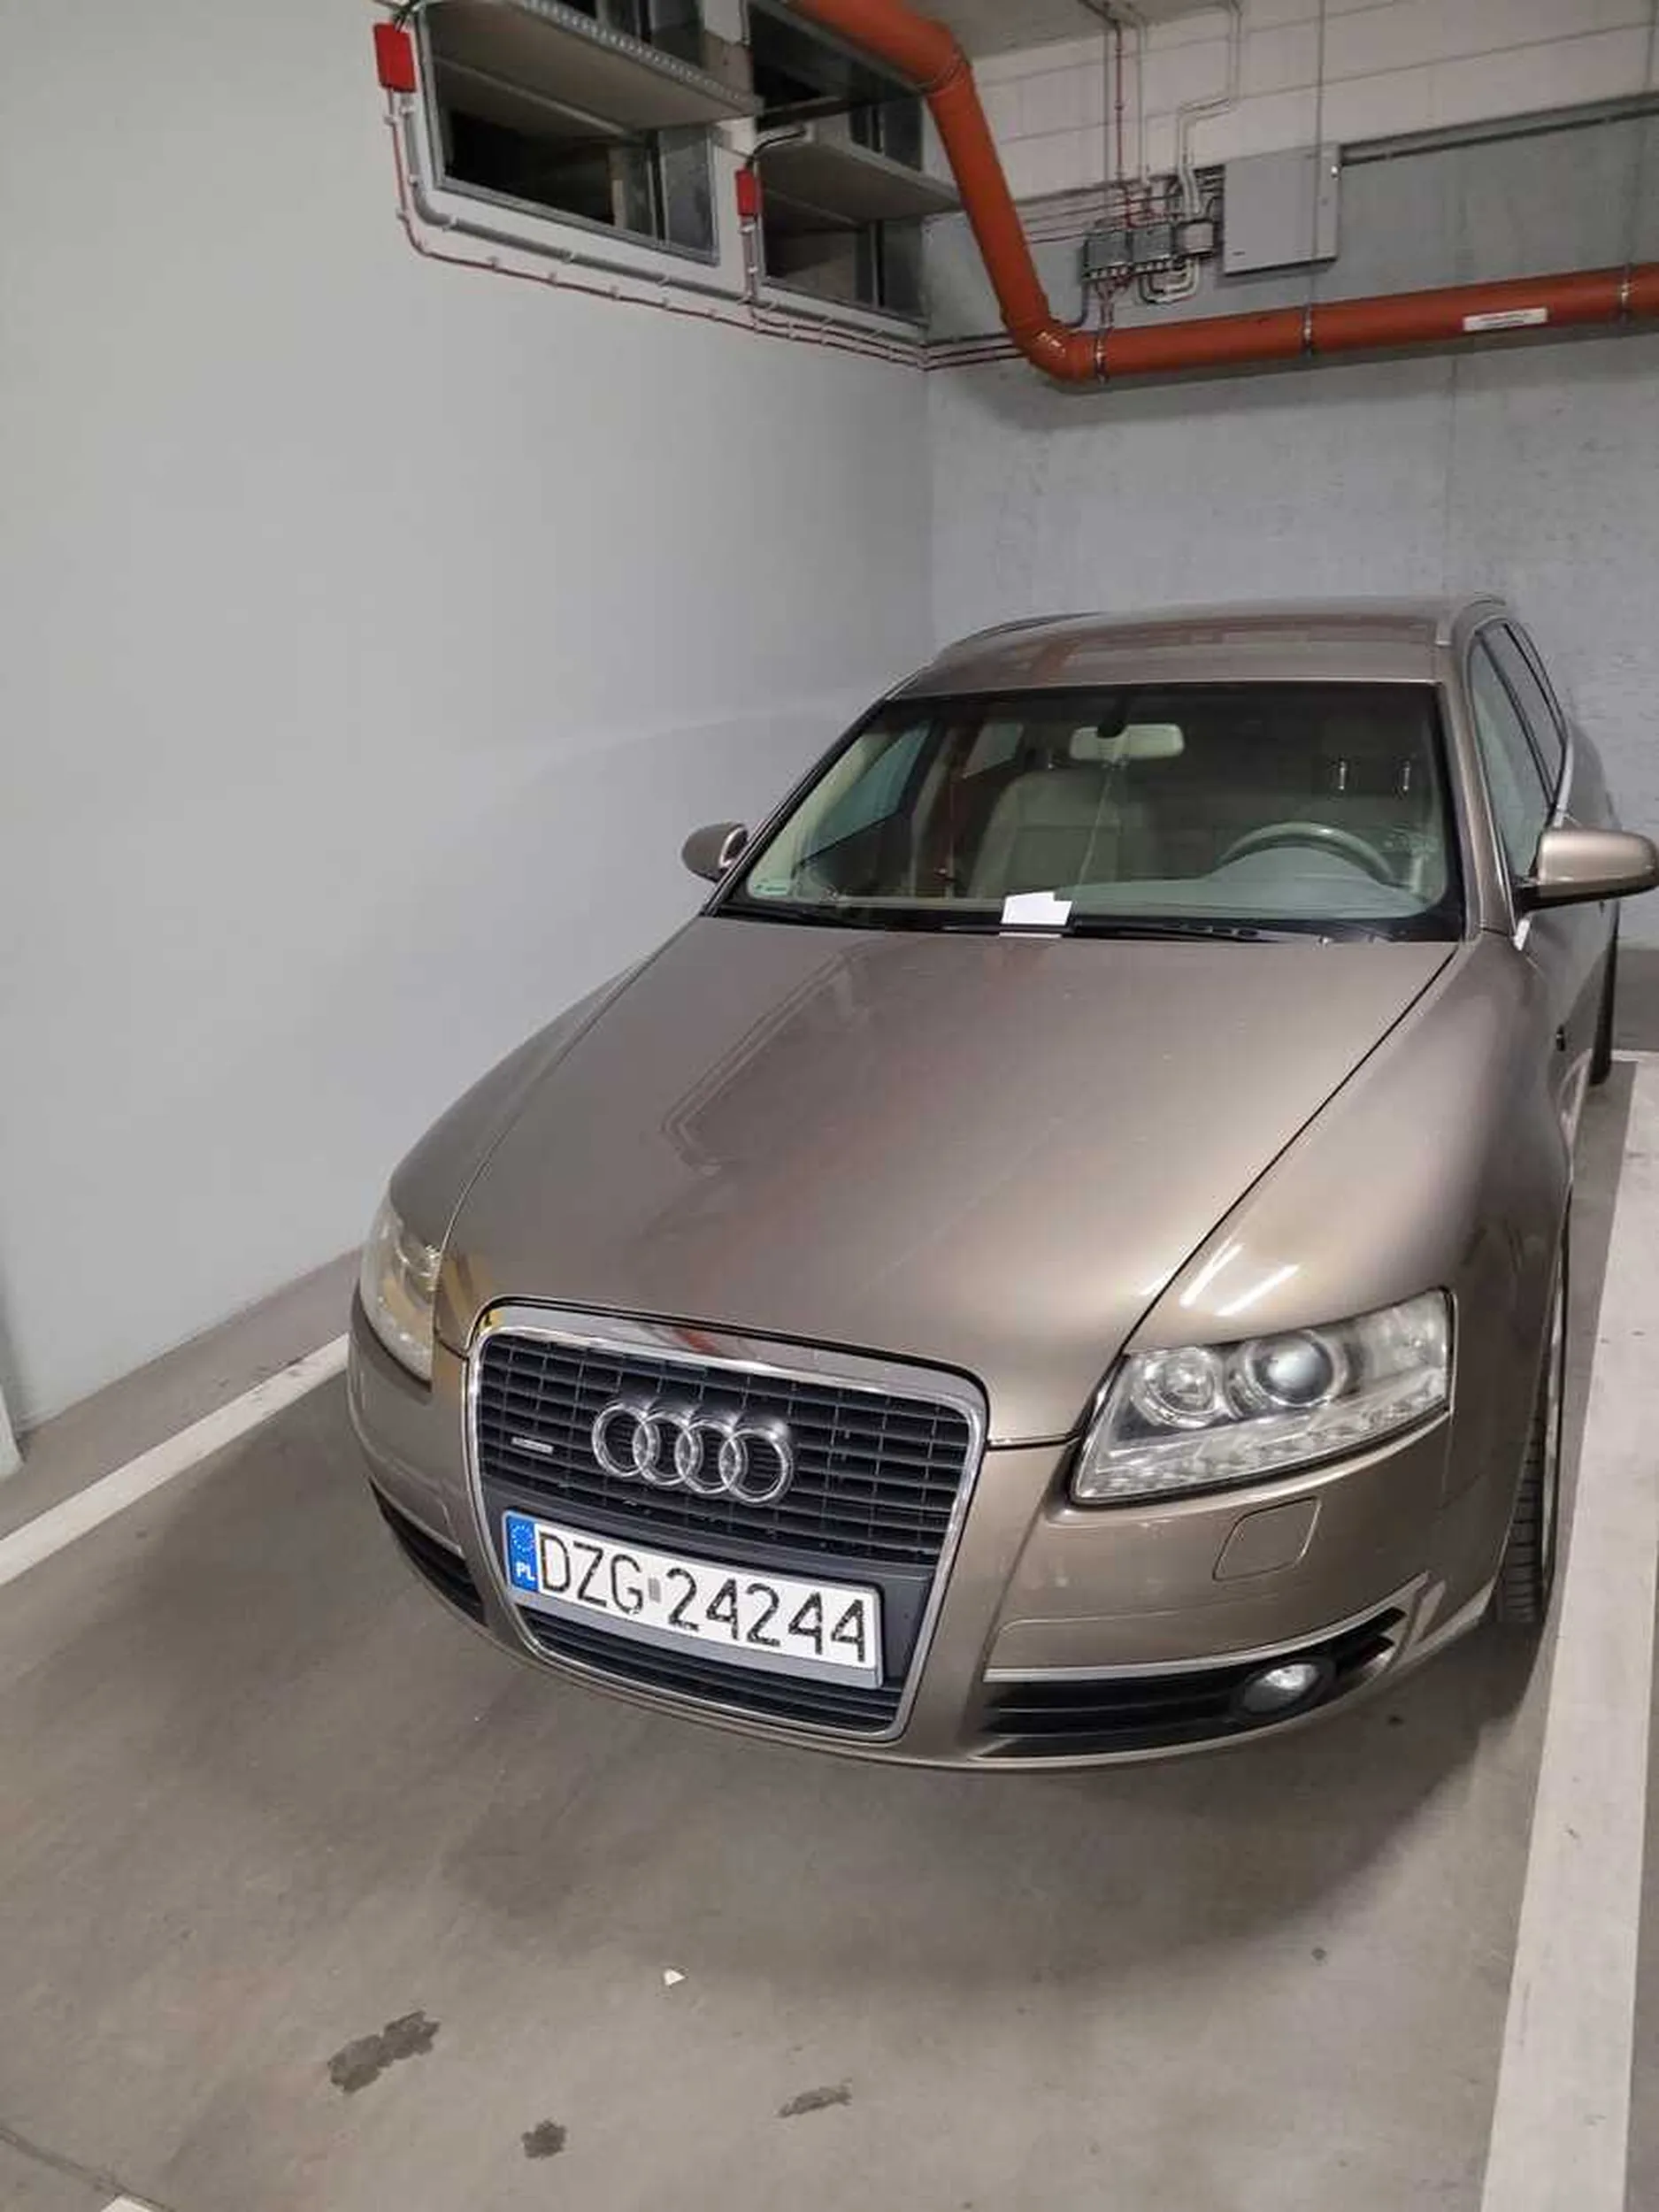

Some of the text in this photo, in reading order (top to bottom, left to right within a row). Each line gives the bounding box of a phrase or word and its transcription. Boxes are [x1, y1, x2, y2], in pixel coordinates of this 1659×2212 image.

[515, 1561, 536, 1582] PL
[539, 1531, 865, 1663] DZG 24244
